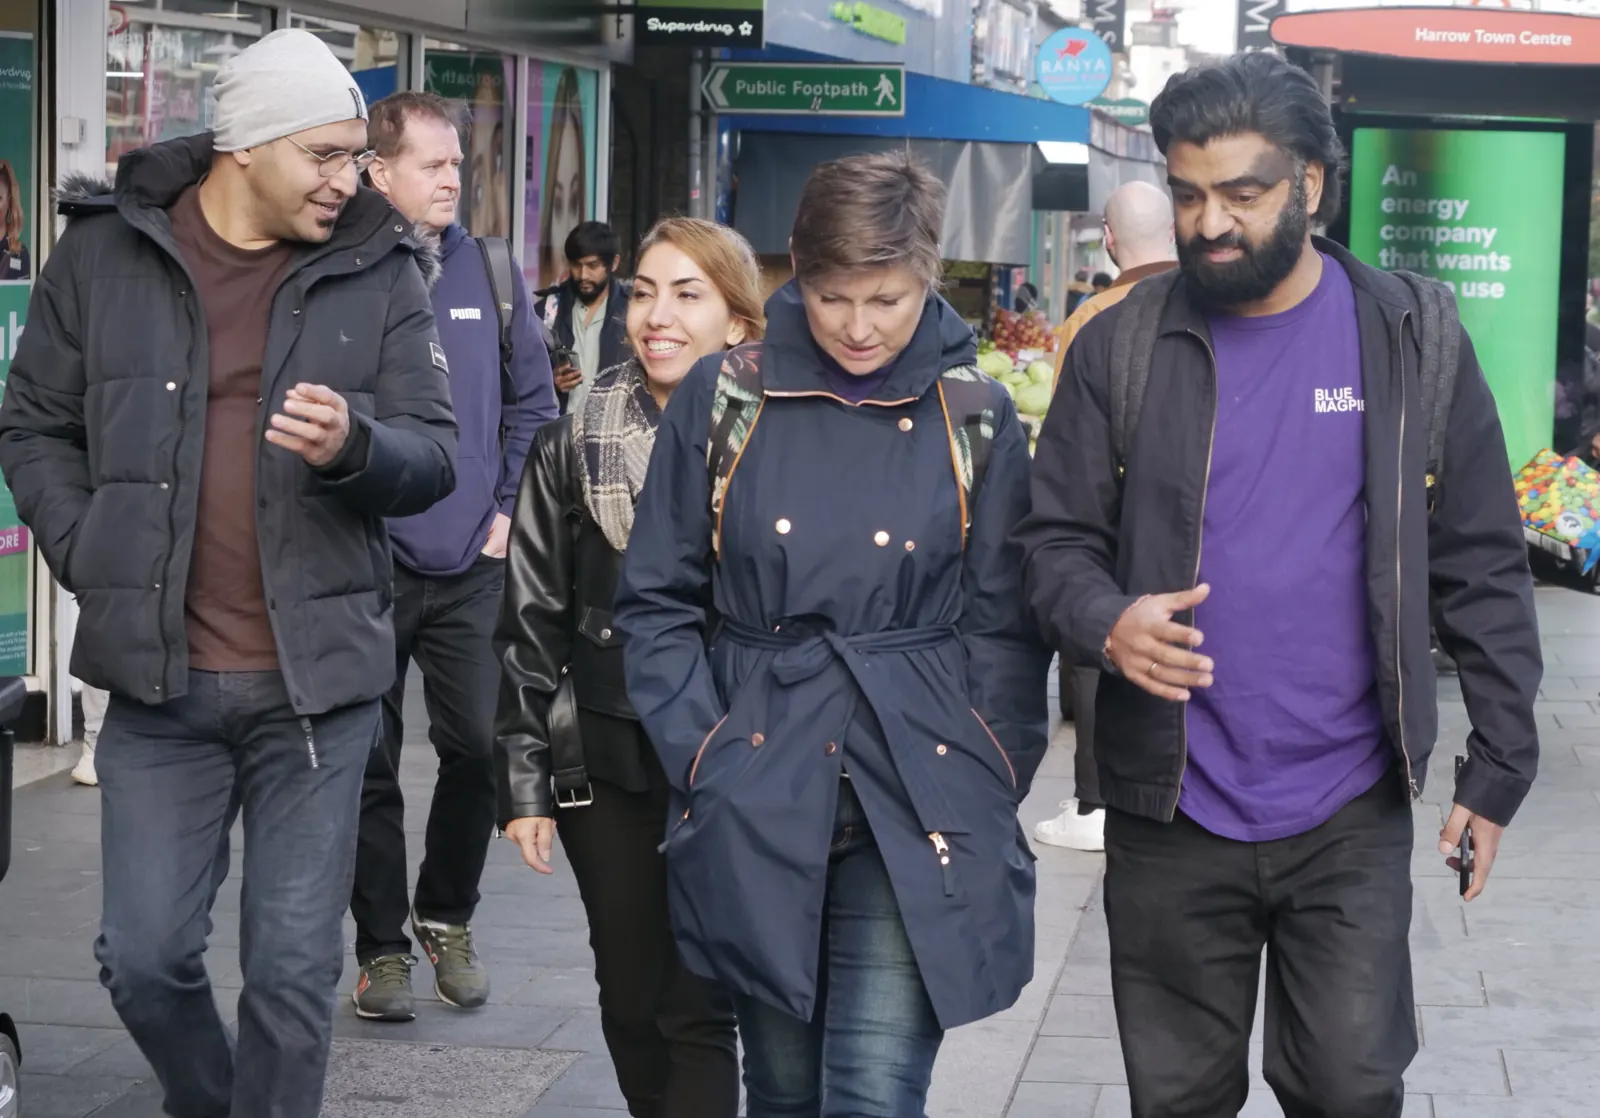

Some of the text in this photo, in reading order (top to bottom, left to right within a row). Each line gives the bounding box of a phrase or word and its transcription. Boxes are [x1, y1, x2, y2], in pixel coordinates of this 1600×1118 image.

[647, 17, 734, 36] Superdrug
[1415, 27, 1572, 45] Harrow Town Centre
[1042, 58, 1106, 74] RANYA
[736, 80, 868, 98] Public Footpath
[1381, 164, 1417, 185] An
[1381, 198, 1470, 220] energy
[1379, 225, 1498, 248] company
[1379, 247, 1512, 271] that wants
[1461, 281, 1506, 298] use
[450, 308, 481, 320] PUMA
[1314, 387, 1353, 401] BLUE
